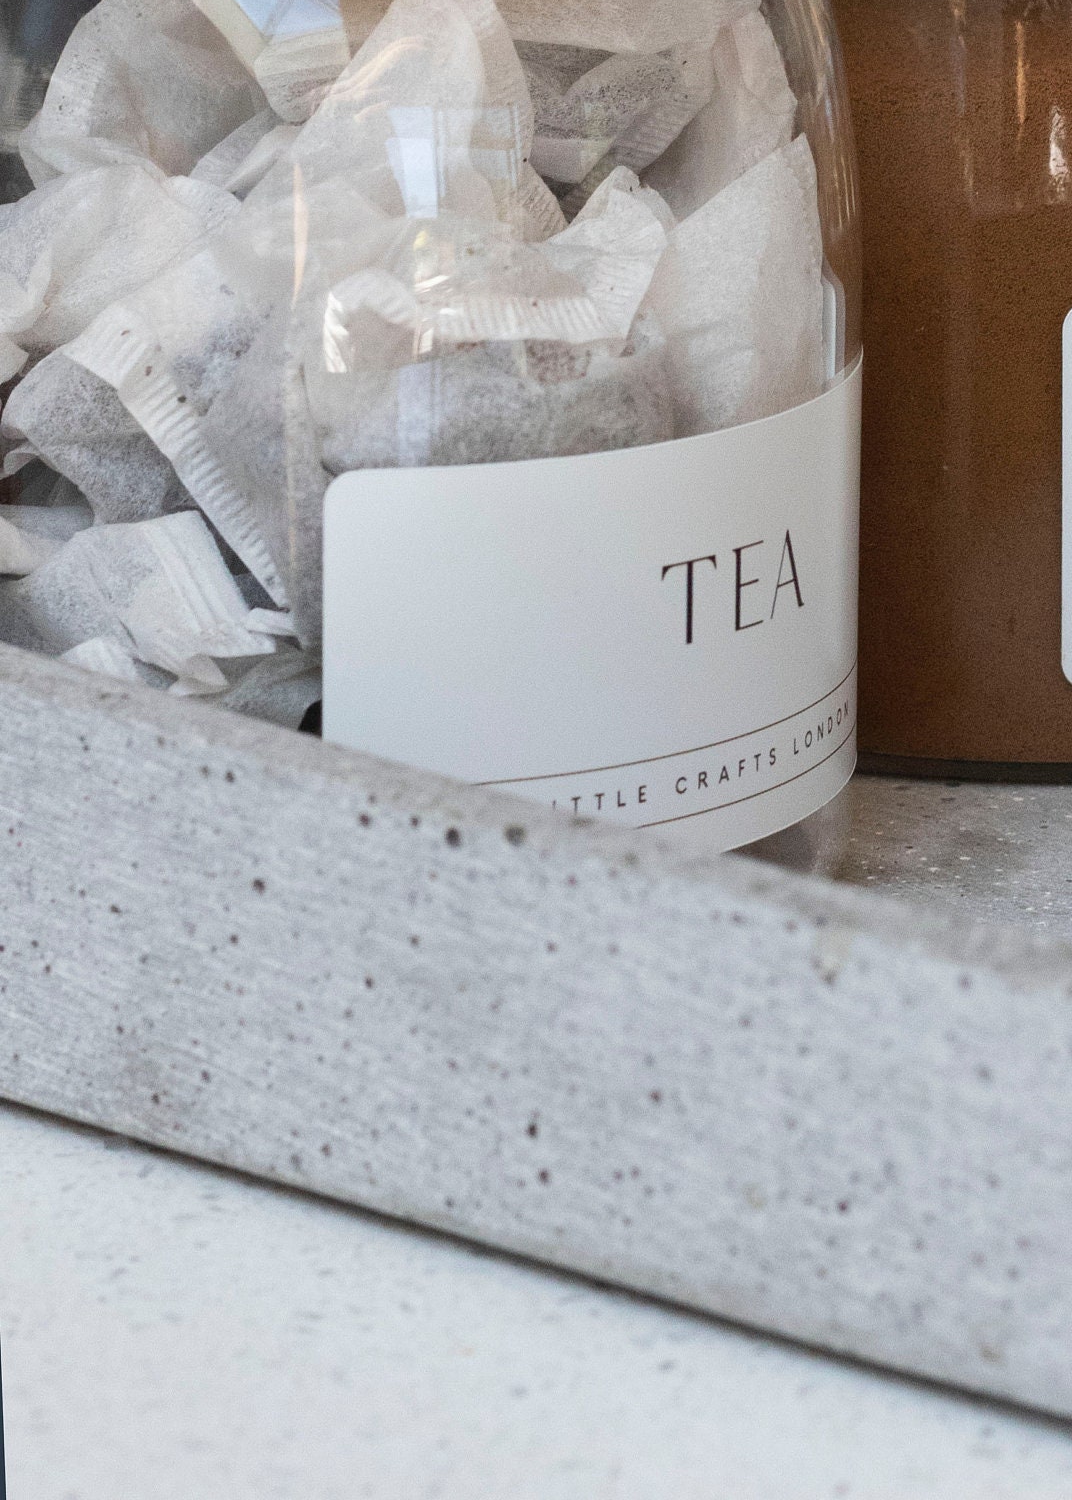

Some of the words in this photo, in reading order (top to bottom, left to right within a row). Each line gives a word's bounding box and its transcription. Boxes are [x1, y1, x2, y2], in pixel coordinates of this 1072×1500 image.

[660, 529, 805, 645] TEA
[675, 747, 777, 795] CRAFTS
[793, 699, 849, 755] LONDON
